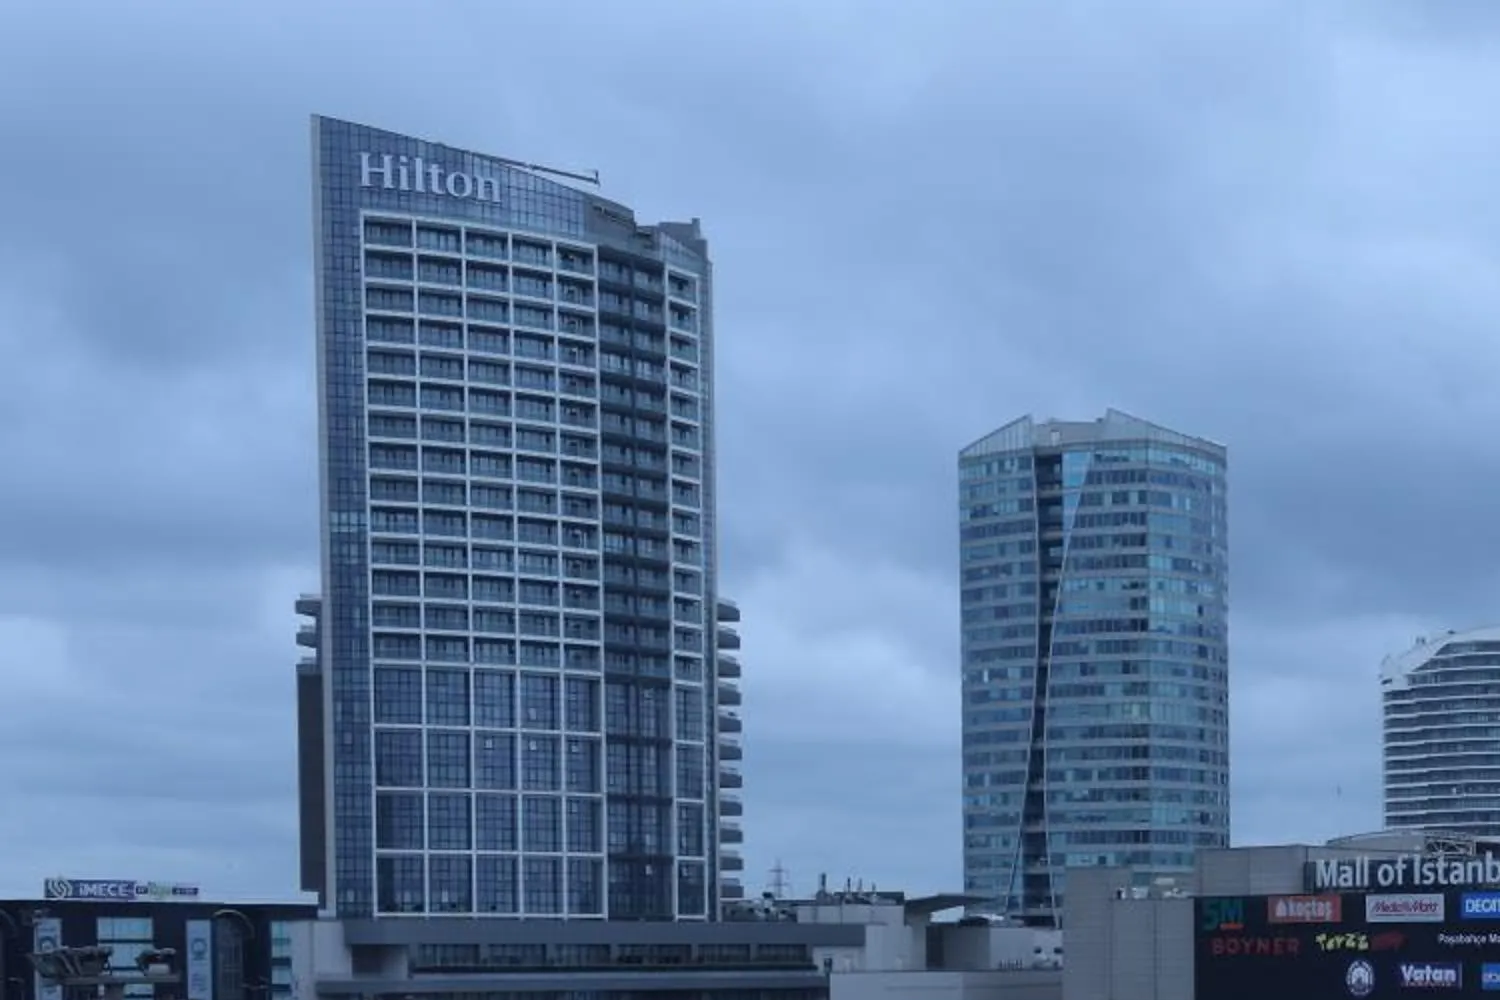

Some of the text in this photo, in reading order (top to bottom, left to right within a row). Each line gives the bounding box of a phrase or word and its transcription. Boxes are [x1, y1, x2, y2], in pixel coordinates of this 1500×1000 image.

[359, 152, 501, 203] Hilton
[1315, 856, 1369, 888] Mall
[1377, 854, 1408, 886] of
[1211, 936, 1301, 956] BOYNER
[1399, 964, 1457, 983] Vatan
